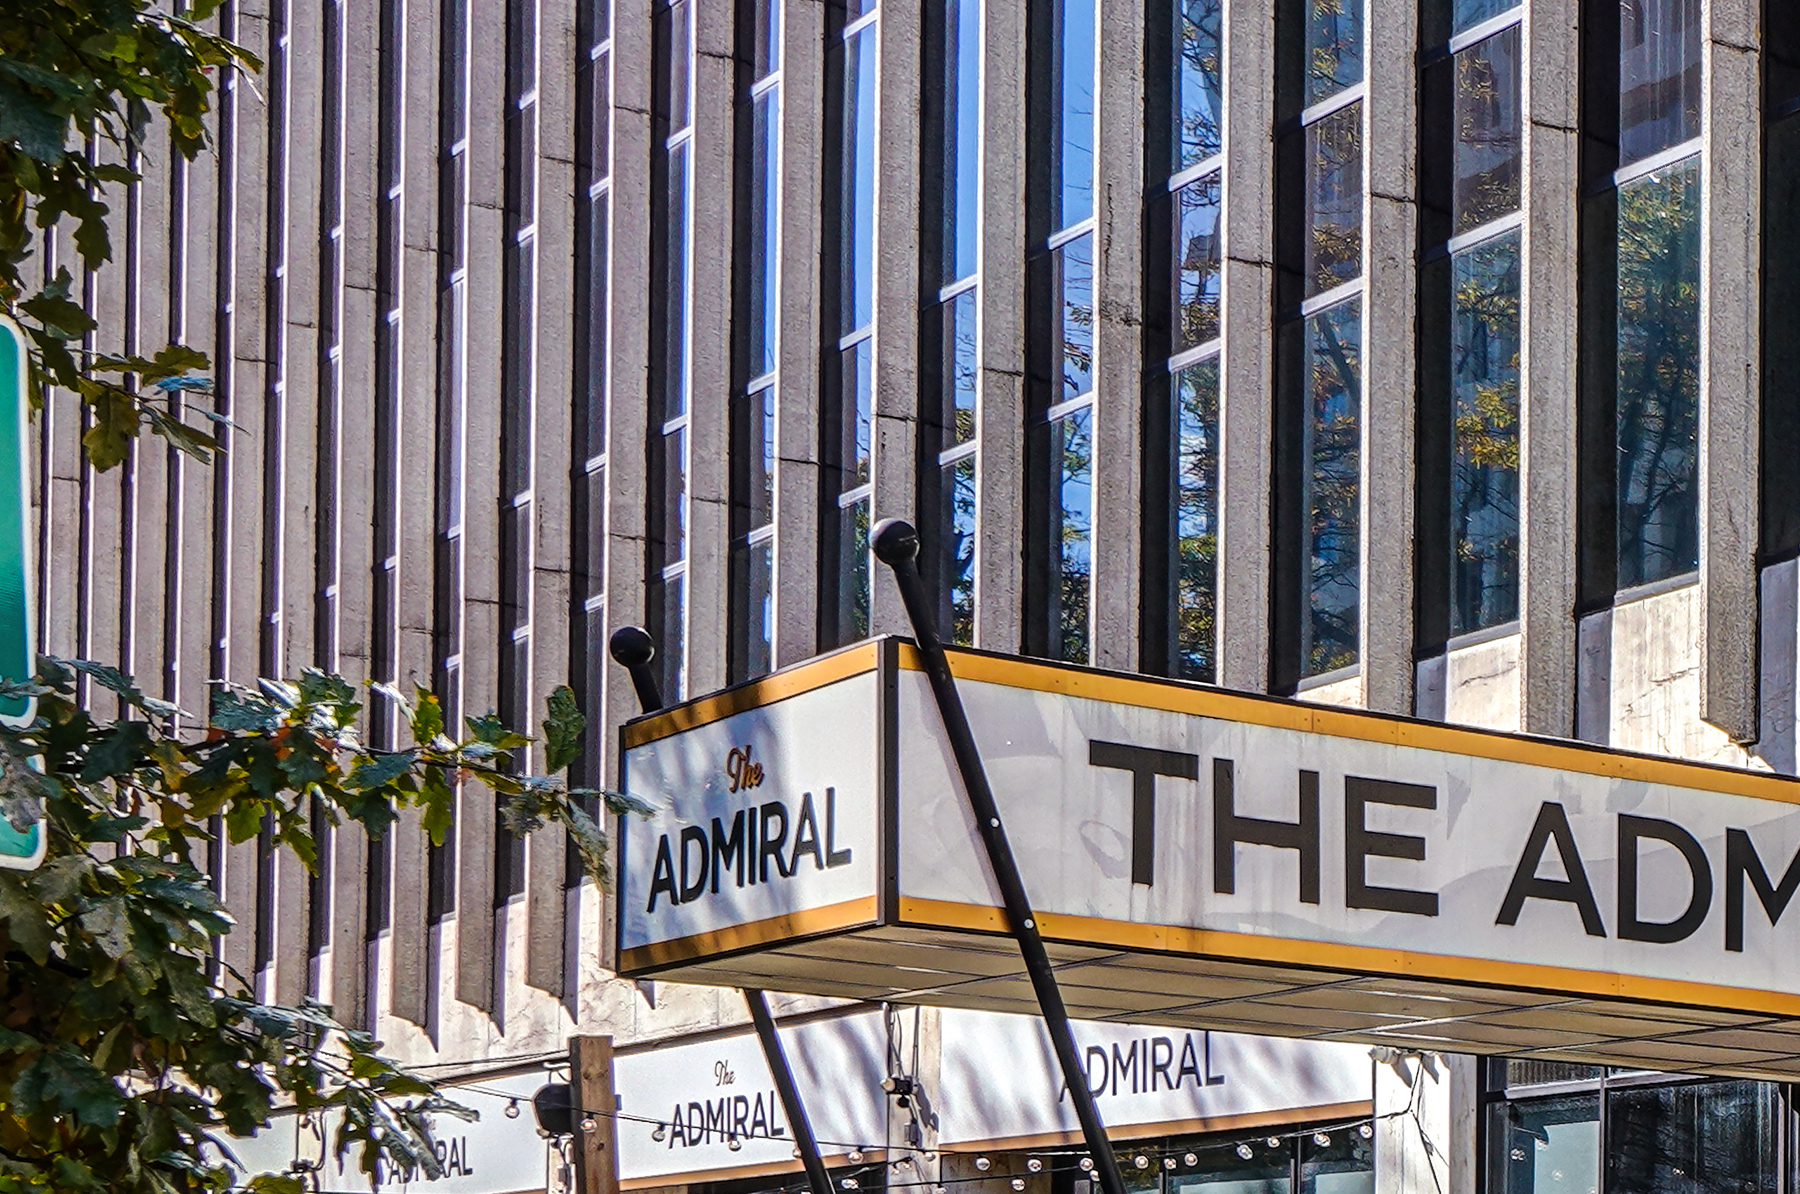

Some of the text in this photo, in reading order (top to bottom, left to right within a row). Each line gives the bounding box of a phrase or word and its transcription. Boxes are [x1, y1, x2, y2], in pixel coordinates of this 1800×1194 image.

[726, 744, 765, 794] The
[646, 786, 852, 914] ADMIRAL
[1088, 738, 1440, 918] THE
[714, 1059, 736, 1087] The
[1058, 1031, 1225, 1103] DMIRAL
[668, 1090, 784, 1149] ADMIRAL
